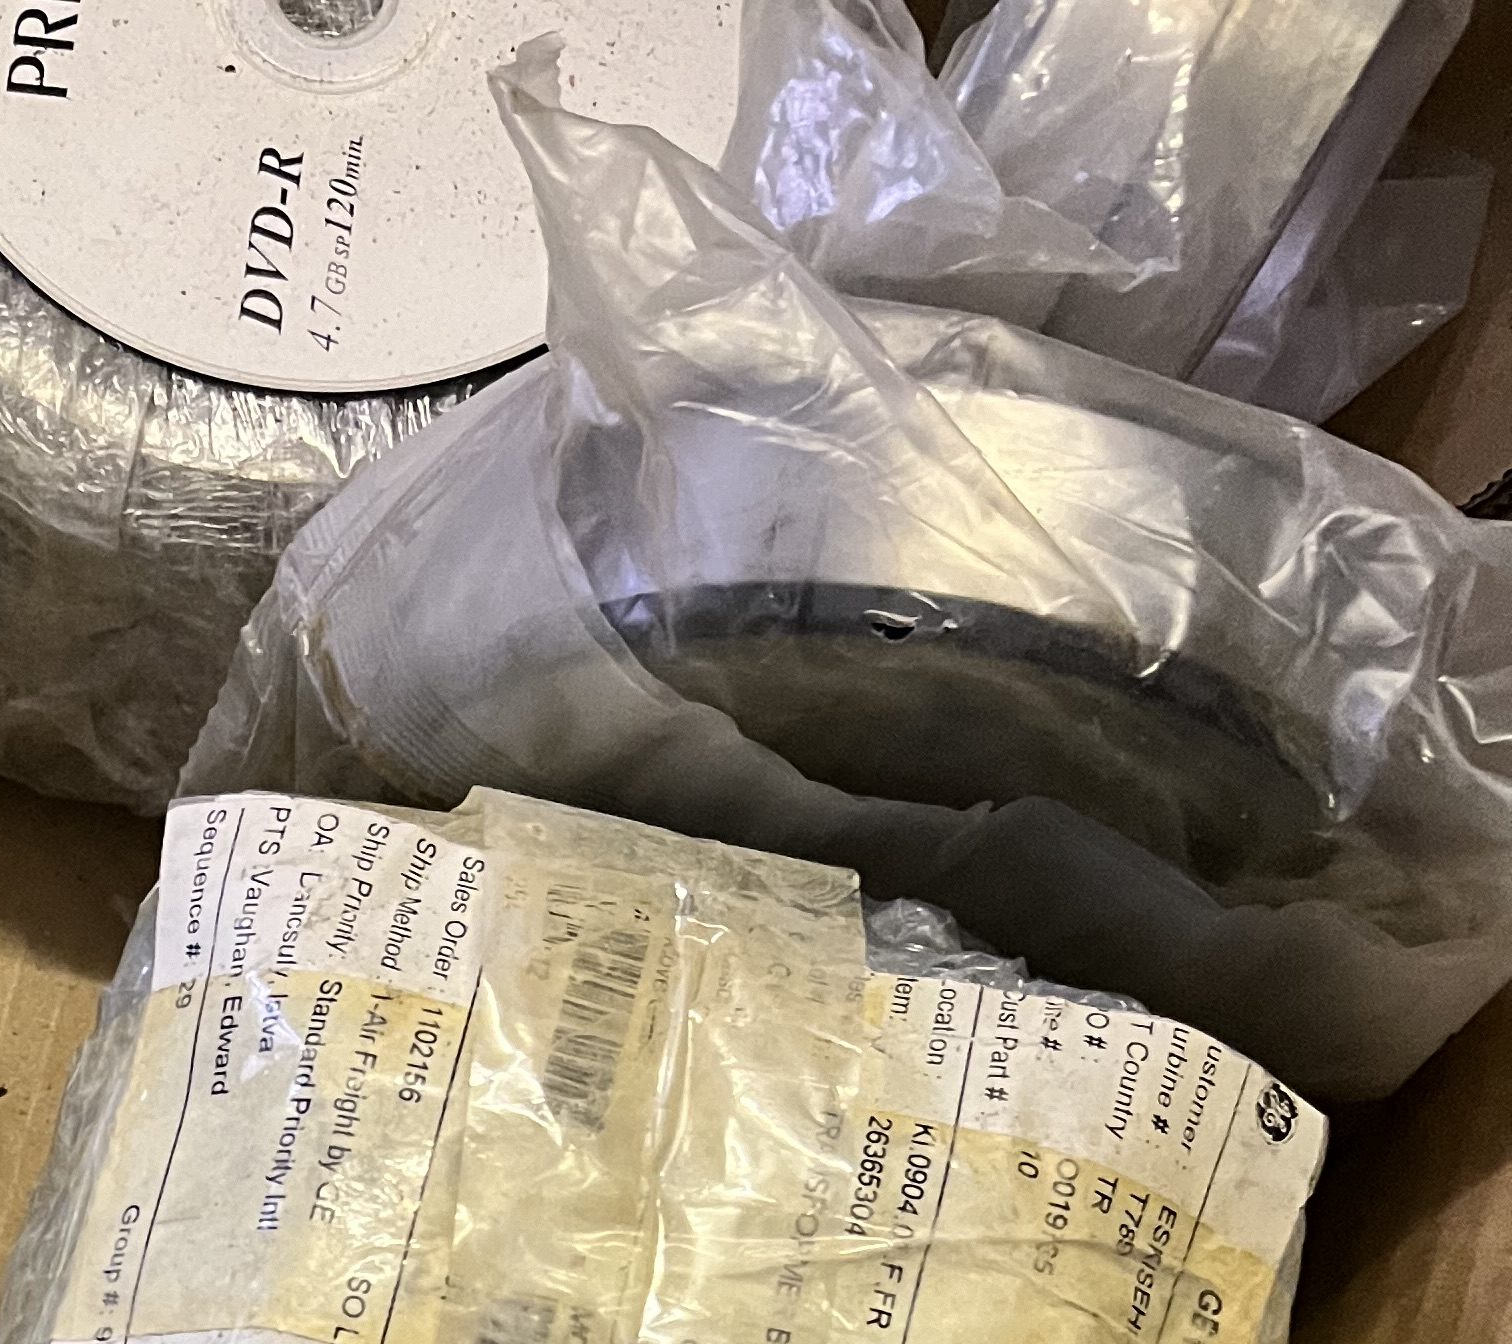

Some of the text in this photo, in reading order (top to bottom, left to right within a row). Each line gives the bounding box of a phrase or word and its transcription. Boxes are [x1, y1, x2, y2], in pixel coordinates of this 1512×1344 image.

[6, 0, 80, 98] PR
[238, 145, 305, 334] DVD-R
[306, 296, 344, 353] 4.7
[325, 260, 349, 296] GB
[257, 803, 291, 858] PTS
[346, 819, 390, 874] Ship
[397, 835, 437, 893] Ship
[185, 808, 229, 935] Sequence
[449, 854, 485, 915] Sales
[379, 893, 421, 972] Method
[431, 918, 468, 982] Order
[174, 981, 195, 1010] 29
[296, 979, 343, 1088] Standard
[209, 994, 246, 1098] Edward
[397, 1004, 443, 1105] 1102156
[986, 1034, 1019, 1082] Part
[330, 1050, 376, 1138] Freight
[1102, 1039, 1150, 1140] Country
[264, 1094, 312, 1187] Priority
[316, 1142, 351, 1175] by
[841, 1114, 895, 1237] 26365304
[1014, 1148, 1043, 1180] 10
[1089, 1173, 1118, 1214] TR
[104, 1203, 141, 1284] Group
[338, 1275, 372, 1320] SO
